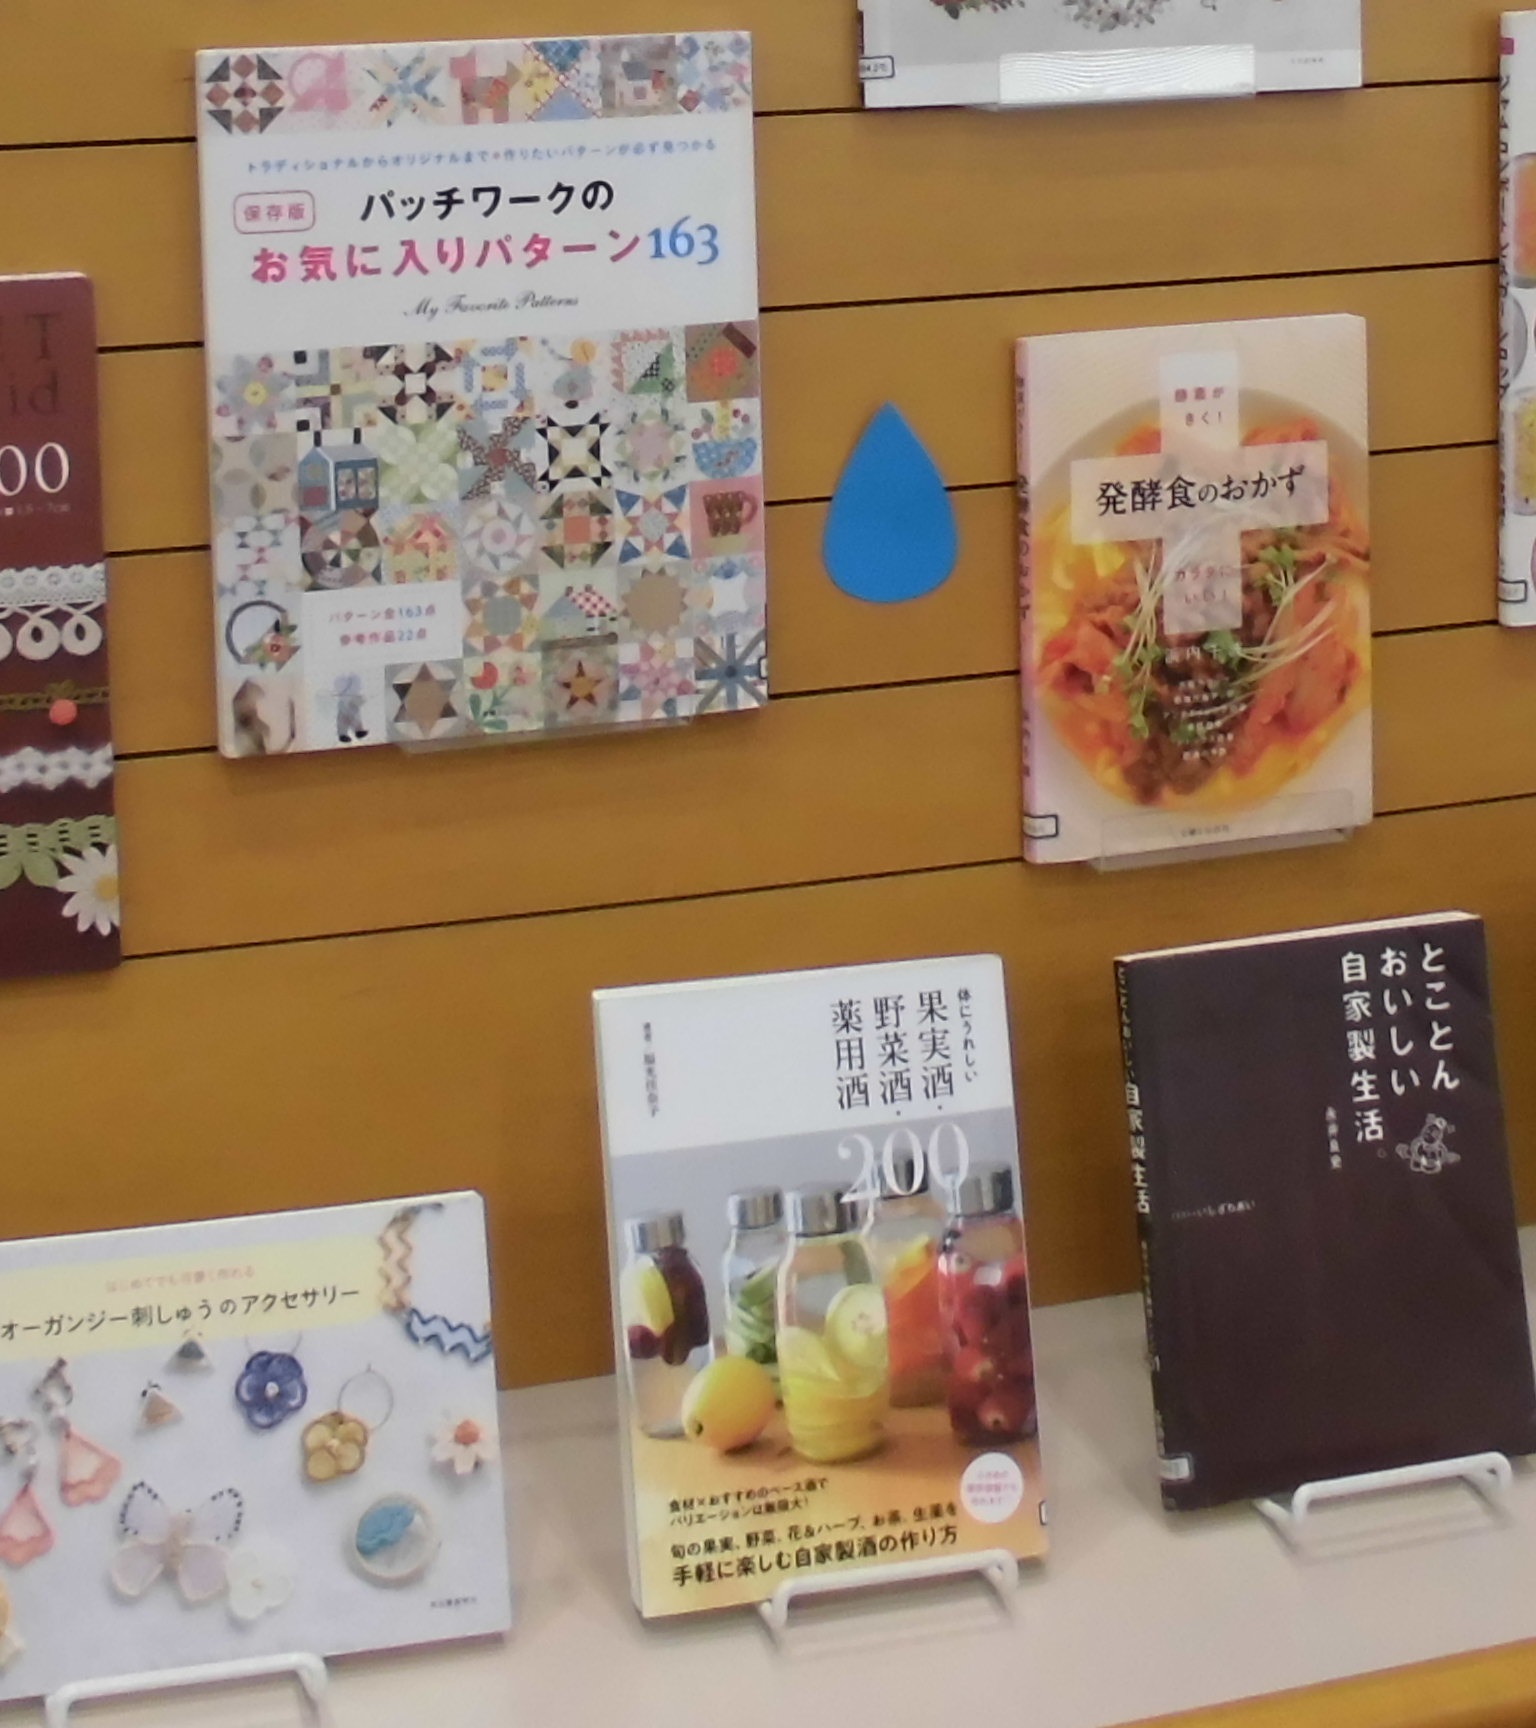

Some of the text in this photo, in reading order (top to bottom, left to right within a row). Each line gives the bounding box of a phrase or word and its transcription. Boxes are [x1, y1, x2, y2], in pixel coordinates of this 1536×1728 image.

[244, 203, 307, 223] 保存版
[361, 180, 615, 222] パッチワークの
[403, 289, 580, 319] My Favorite Patterns
[1096, 465, 1306, 516] 発酵食のおかず
[1340, 951, 1385, 1143] 自家製生活
[1379, 946, 1420, 1096] おいしい
[1420, 943, 1460, 1091] とことん
[830, 998, 871, 1110] 薬用酒
[836, 1122, 970, 1205] 200
[0, 1286, 361, 1341] オーガンジー刺しゅうのアクセサリー
[673, 1526, 958, 1587] 手軽に楽しむ自家製酒の作り方
